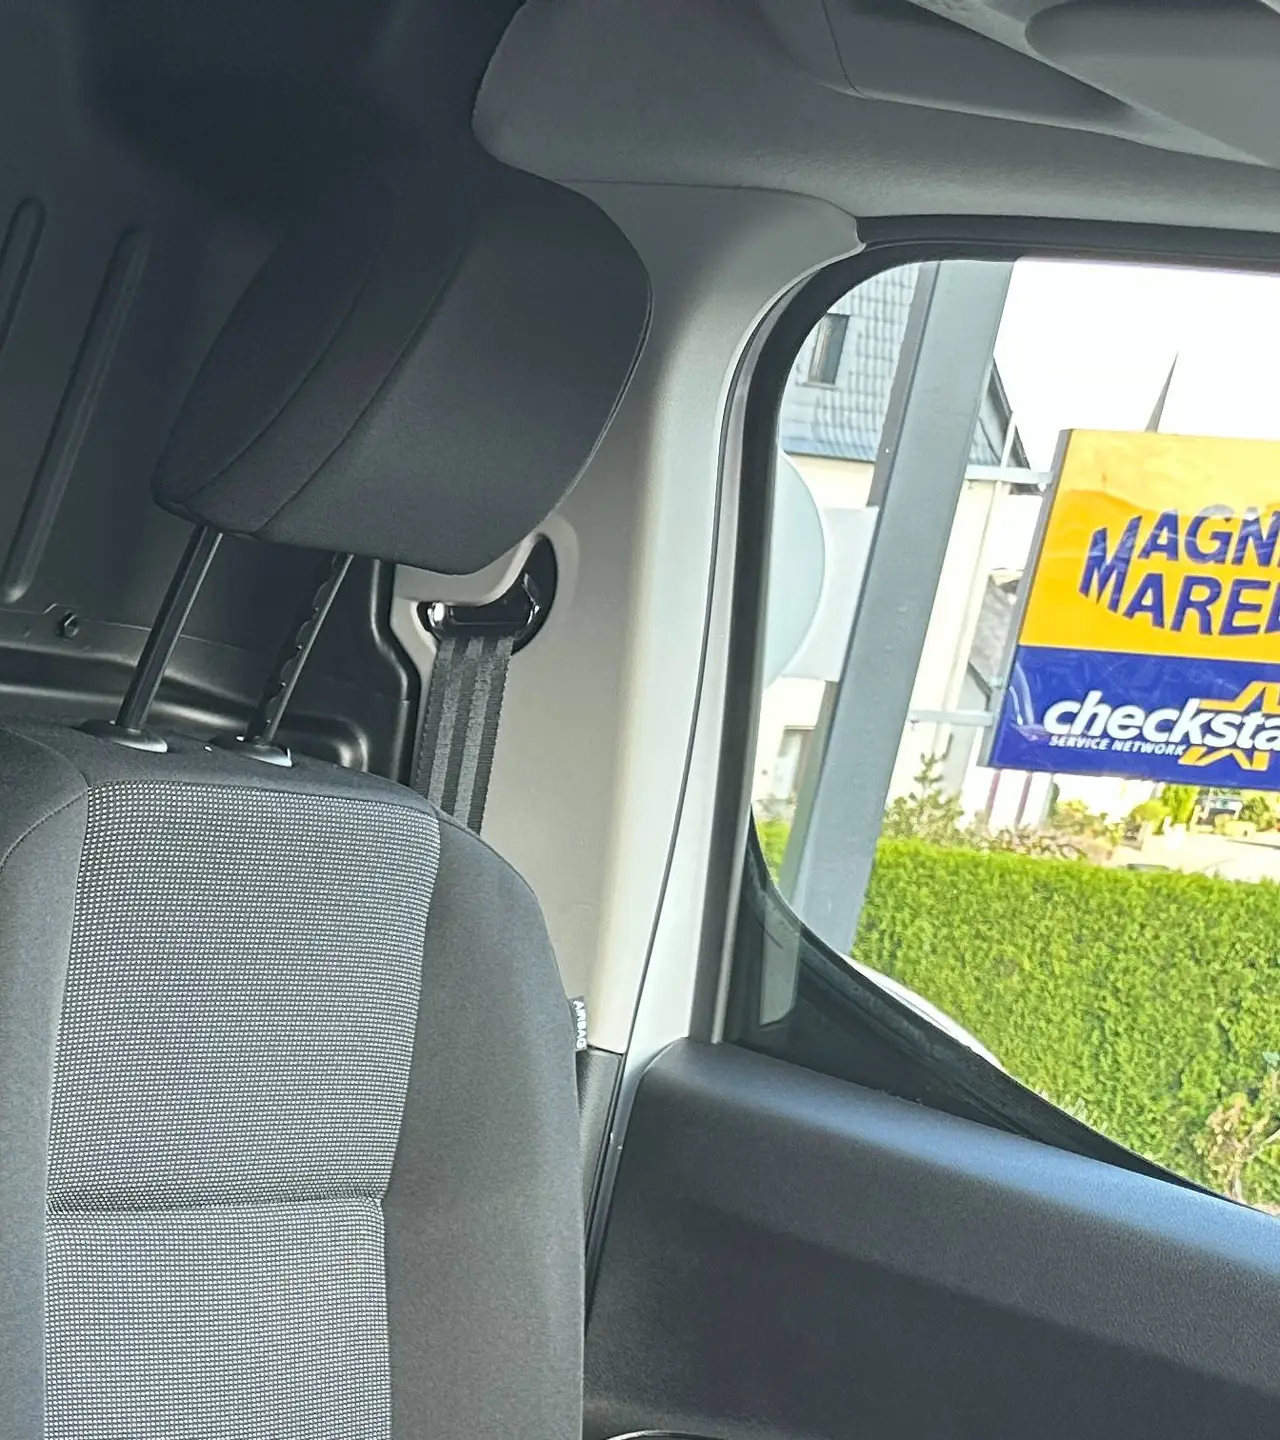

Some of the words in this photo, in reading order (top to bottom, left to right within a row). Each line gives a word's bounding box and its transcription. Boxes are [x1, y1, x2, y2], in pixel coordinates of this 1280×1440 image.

[1079, 504, 1280, 602] MAGN
[1048, 734, 1111, 750] SERVICE
[1111, 739, 1187, 756] NETWORK
[572, 1000, 588, 1050] AIRBAG
